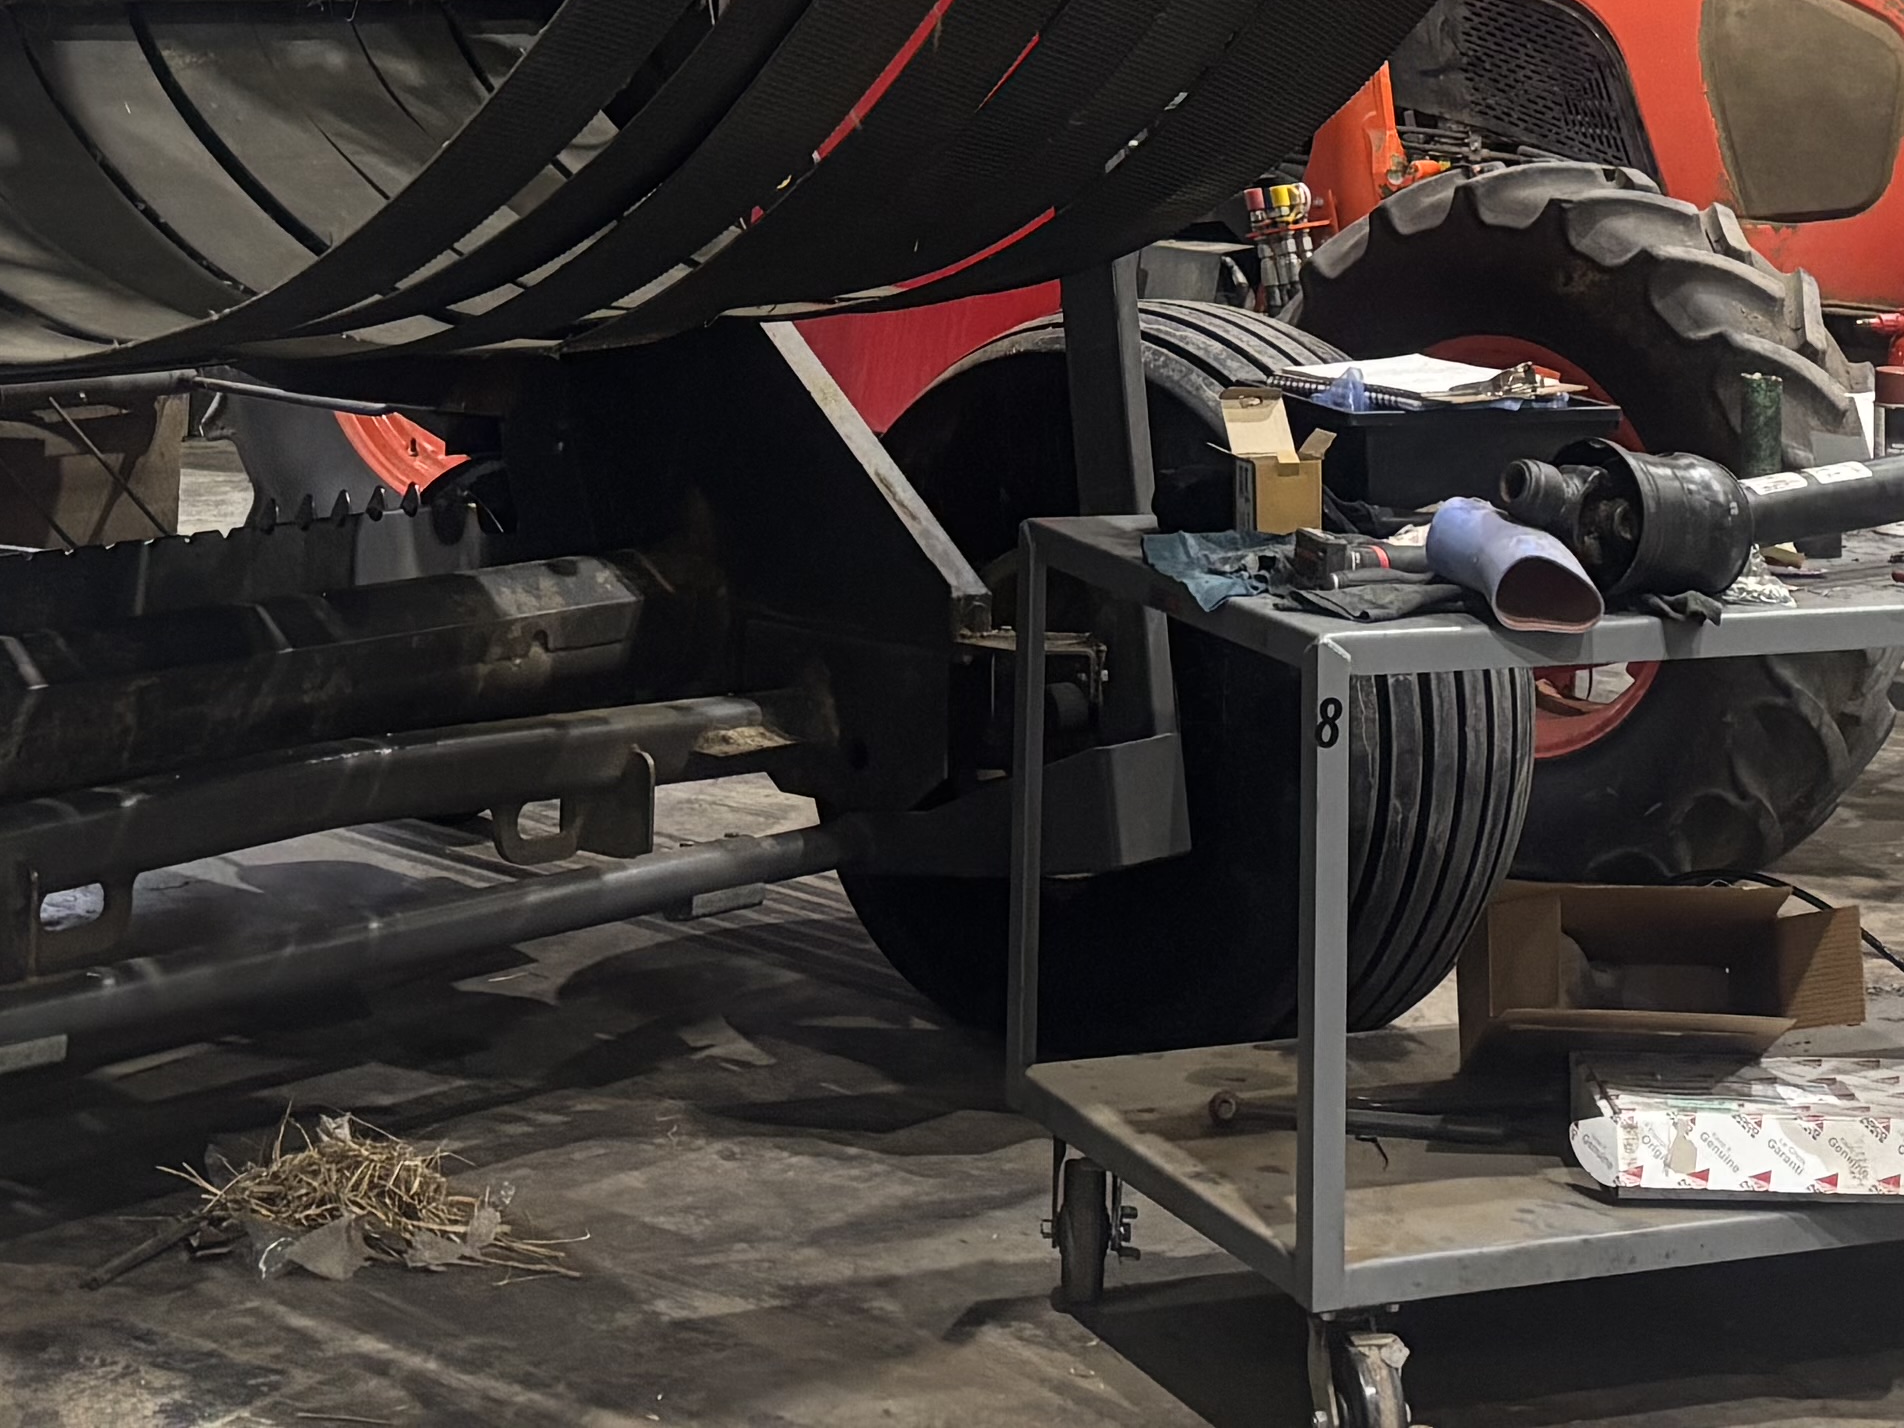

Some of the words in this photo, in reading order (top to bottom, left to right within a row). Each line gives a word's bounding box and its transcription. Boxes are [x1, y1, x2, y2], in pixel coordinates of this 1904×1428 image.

[1314, 696, 1343, 750] 8
[1699, 1131, 1741, 1174] Genuine
[1767, 1138, 1806, 1176] Garanti
